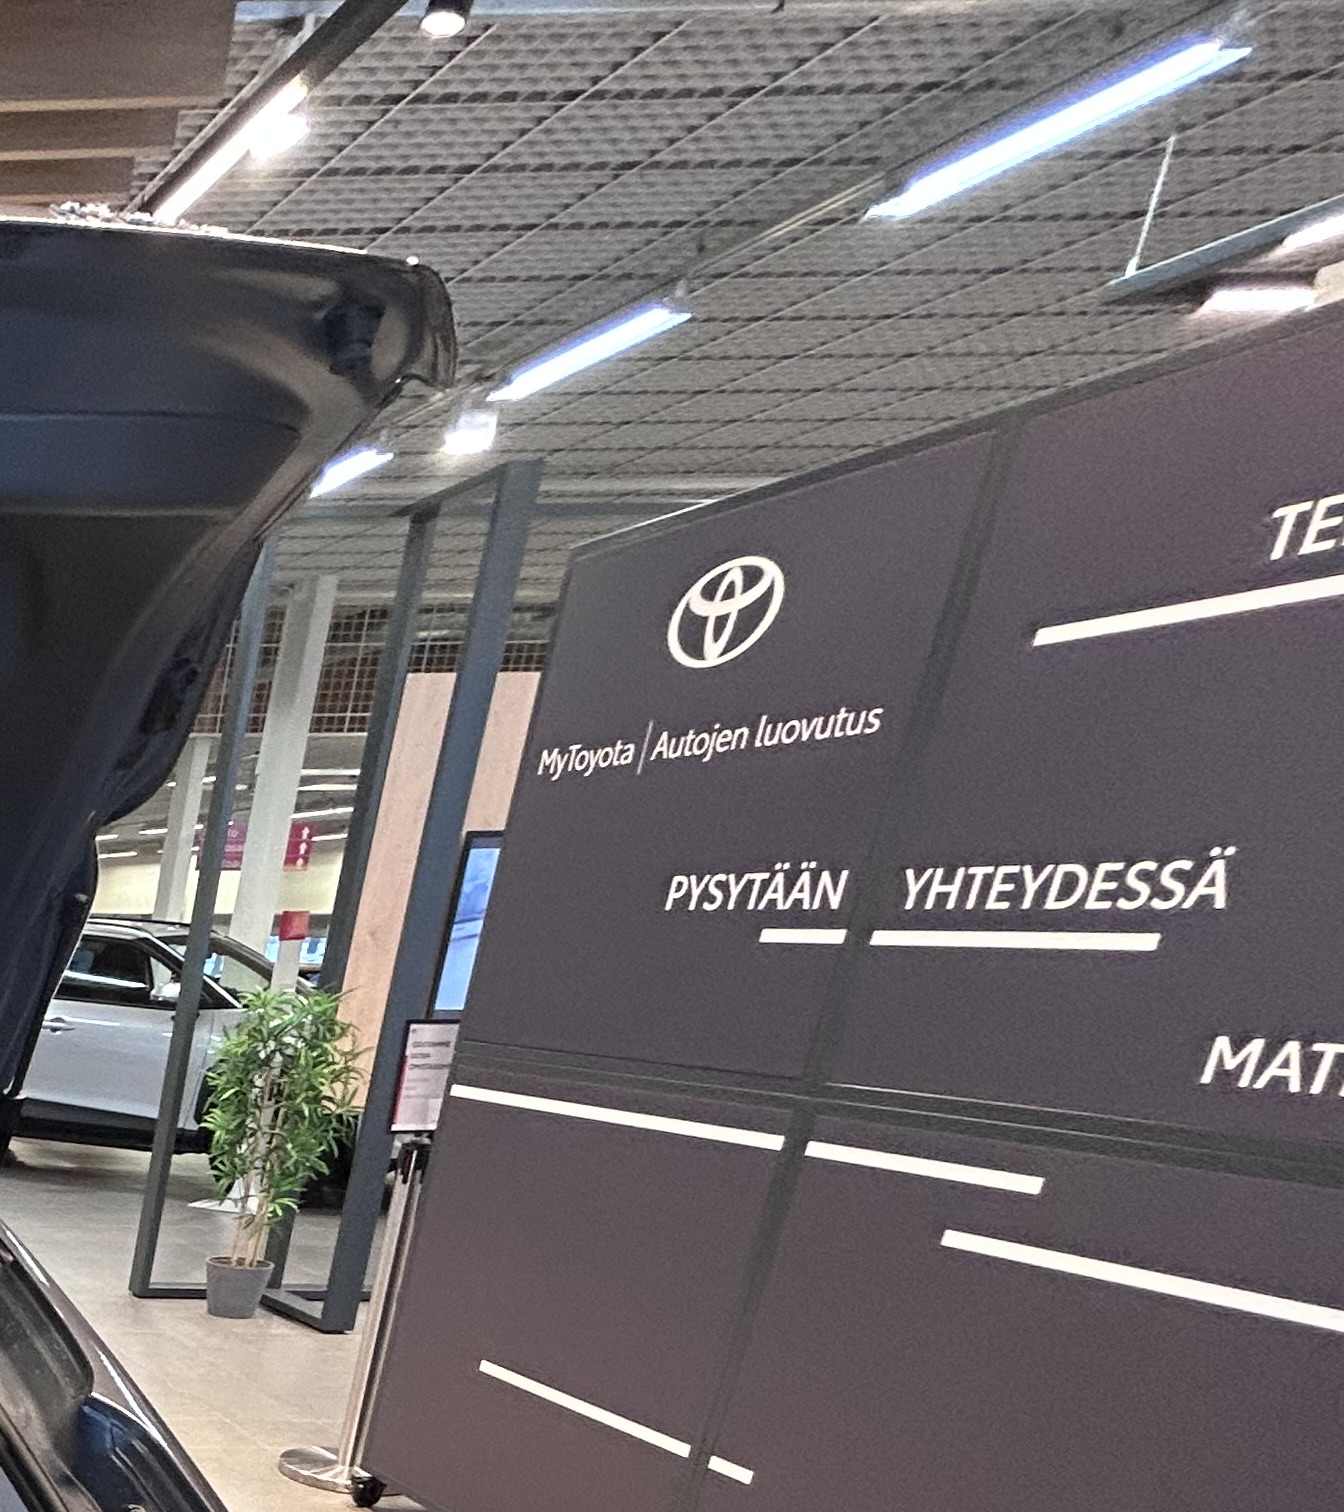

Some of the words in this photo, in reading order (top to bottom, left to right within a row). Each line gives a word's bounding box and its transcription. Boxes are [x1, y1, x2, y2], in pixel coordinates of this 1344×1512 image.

[1269, 493, 1344, 561] TE
[537, 740, 635, 782] MyToyota
[650, 726, 749, 763] Autojen
[755, 706, 884, 749] luovutus
[664, 860, 849, 912] PYSYTÄÄN
[903, 845, 1237, 912] YHTEYDESSÄ
[1199, 1034, 1344, 1098] MAT
